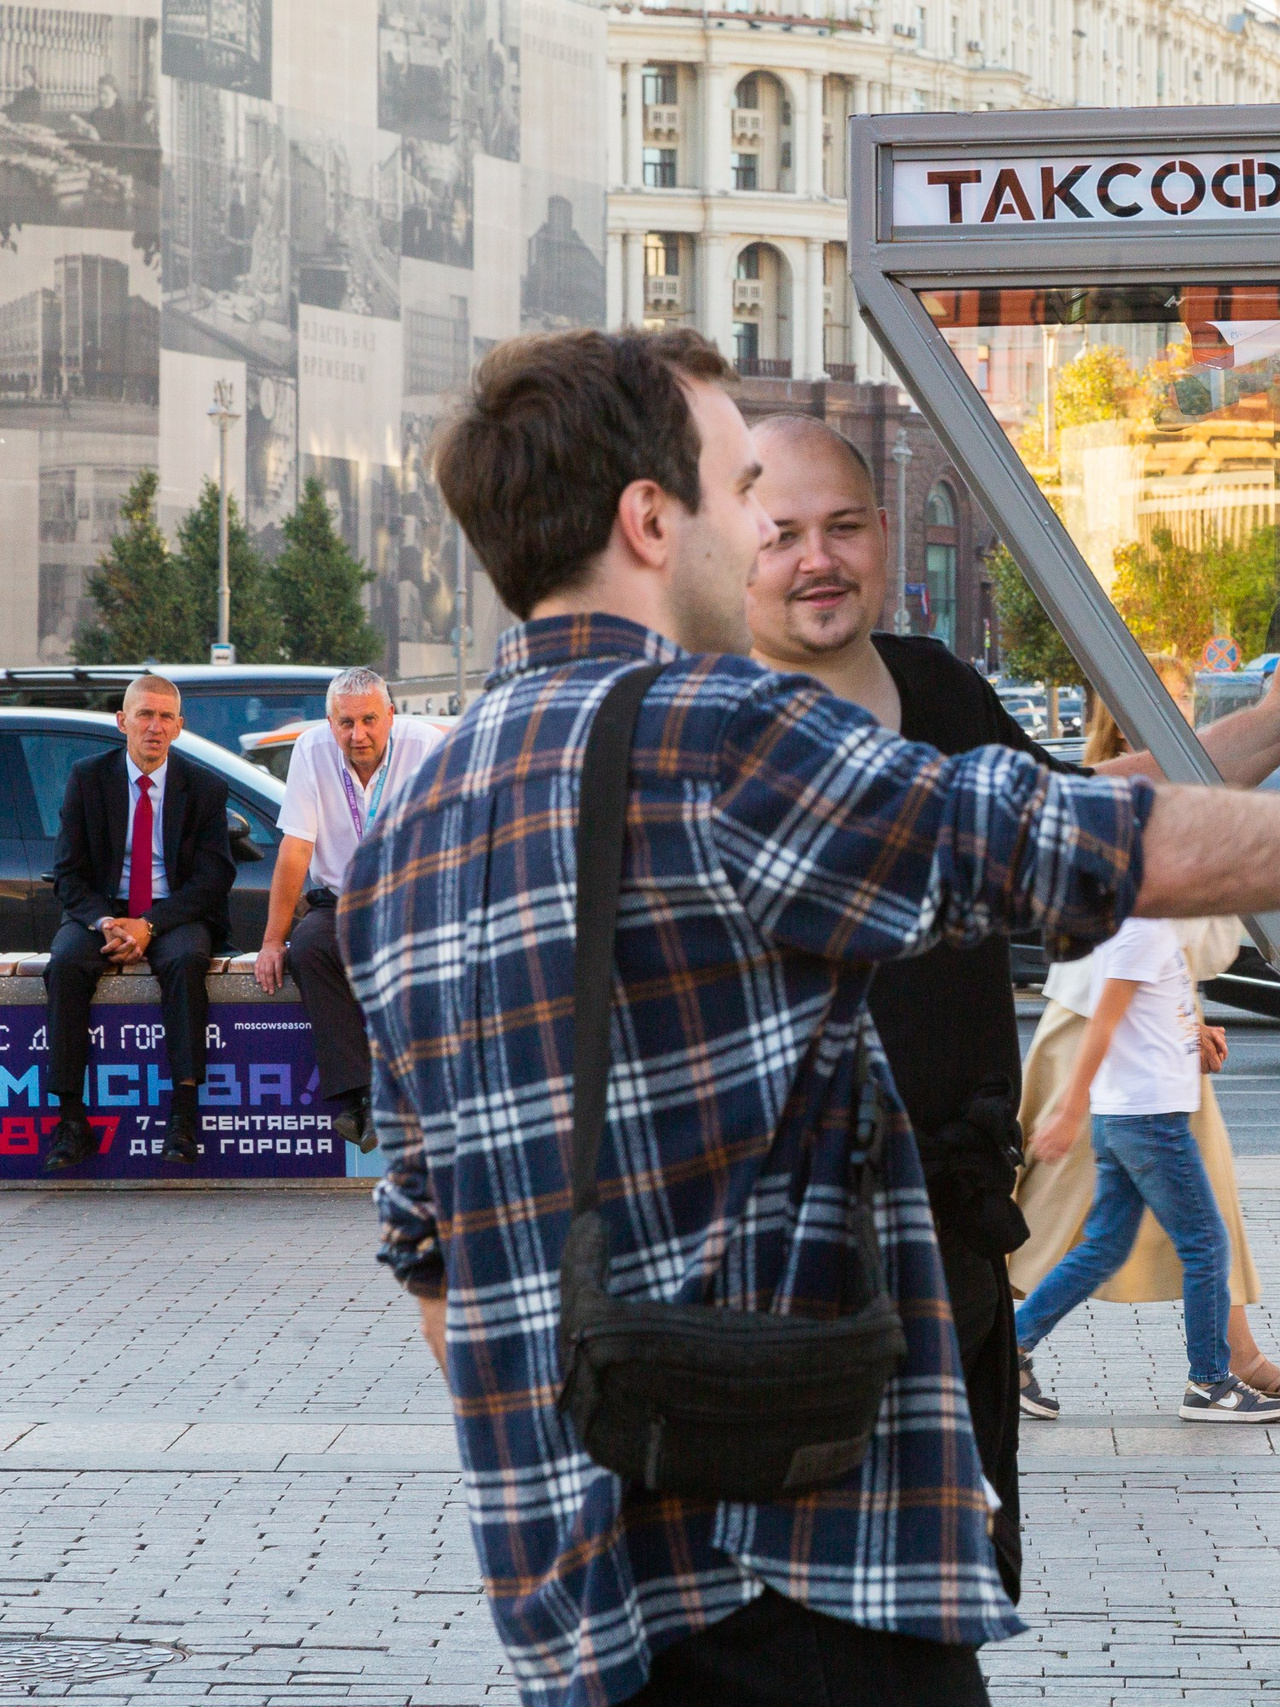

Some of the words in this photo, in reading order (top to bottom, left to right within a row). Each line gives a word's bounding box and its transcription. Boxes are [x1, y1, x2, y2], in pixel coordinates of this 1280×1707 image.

[28, 1024, 105, 1051] ДМ
[120, 1024, 227, 1051] ГОРА,
[0, 1063, 320, 1107] МСКВА!
[201, 1115, 332, 1131] СЕНТЯБРЯ
[219, 1138, 333, 1156] ГОРОДА
